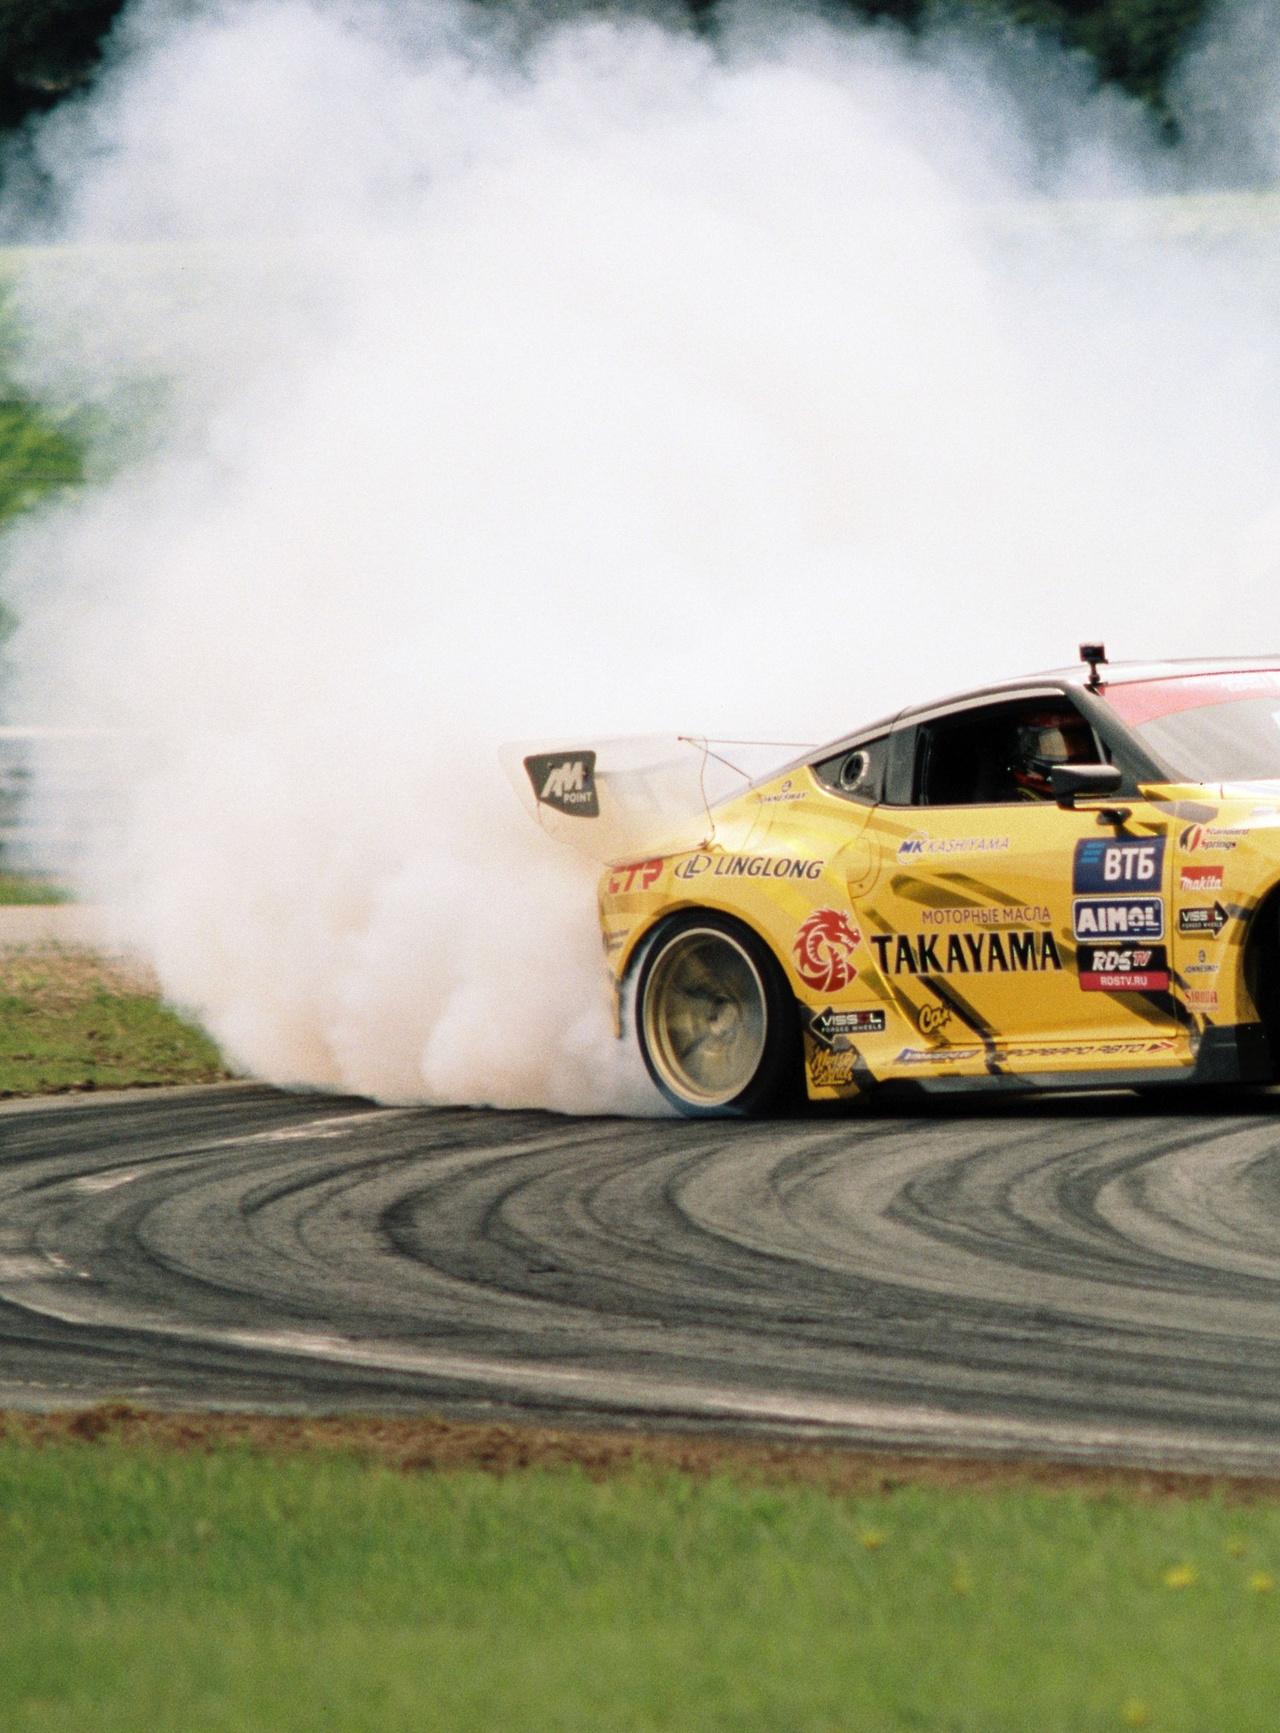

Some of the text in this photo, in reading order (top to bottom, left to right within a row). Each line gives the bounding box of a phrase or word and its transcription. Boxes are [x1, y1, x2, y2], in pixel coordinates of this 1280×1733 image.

[563, 791, 593, 804] POINT
[927, 835, 1010, 853] KASHIYAMA
[714, 856, 824, 880] LINGLONG
[1104, 847, 1155, 881] ВТБ
[922, 906, 1052, 924] МОТОРНЫЕ МАСЛА
[1077, 907, 1160, 933] AIMOL
[870, 930, 1062, 975] TAKAYAMA
[1100, 976, 1147, 986] RDSTV.RU
